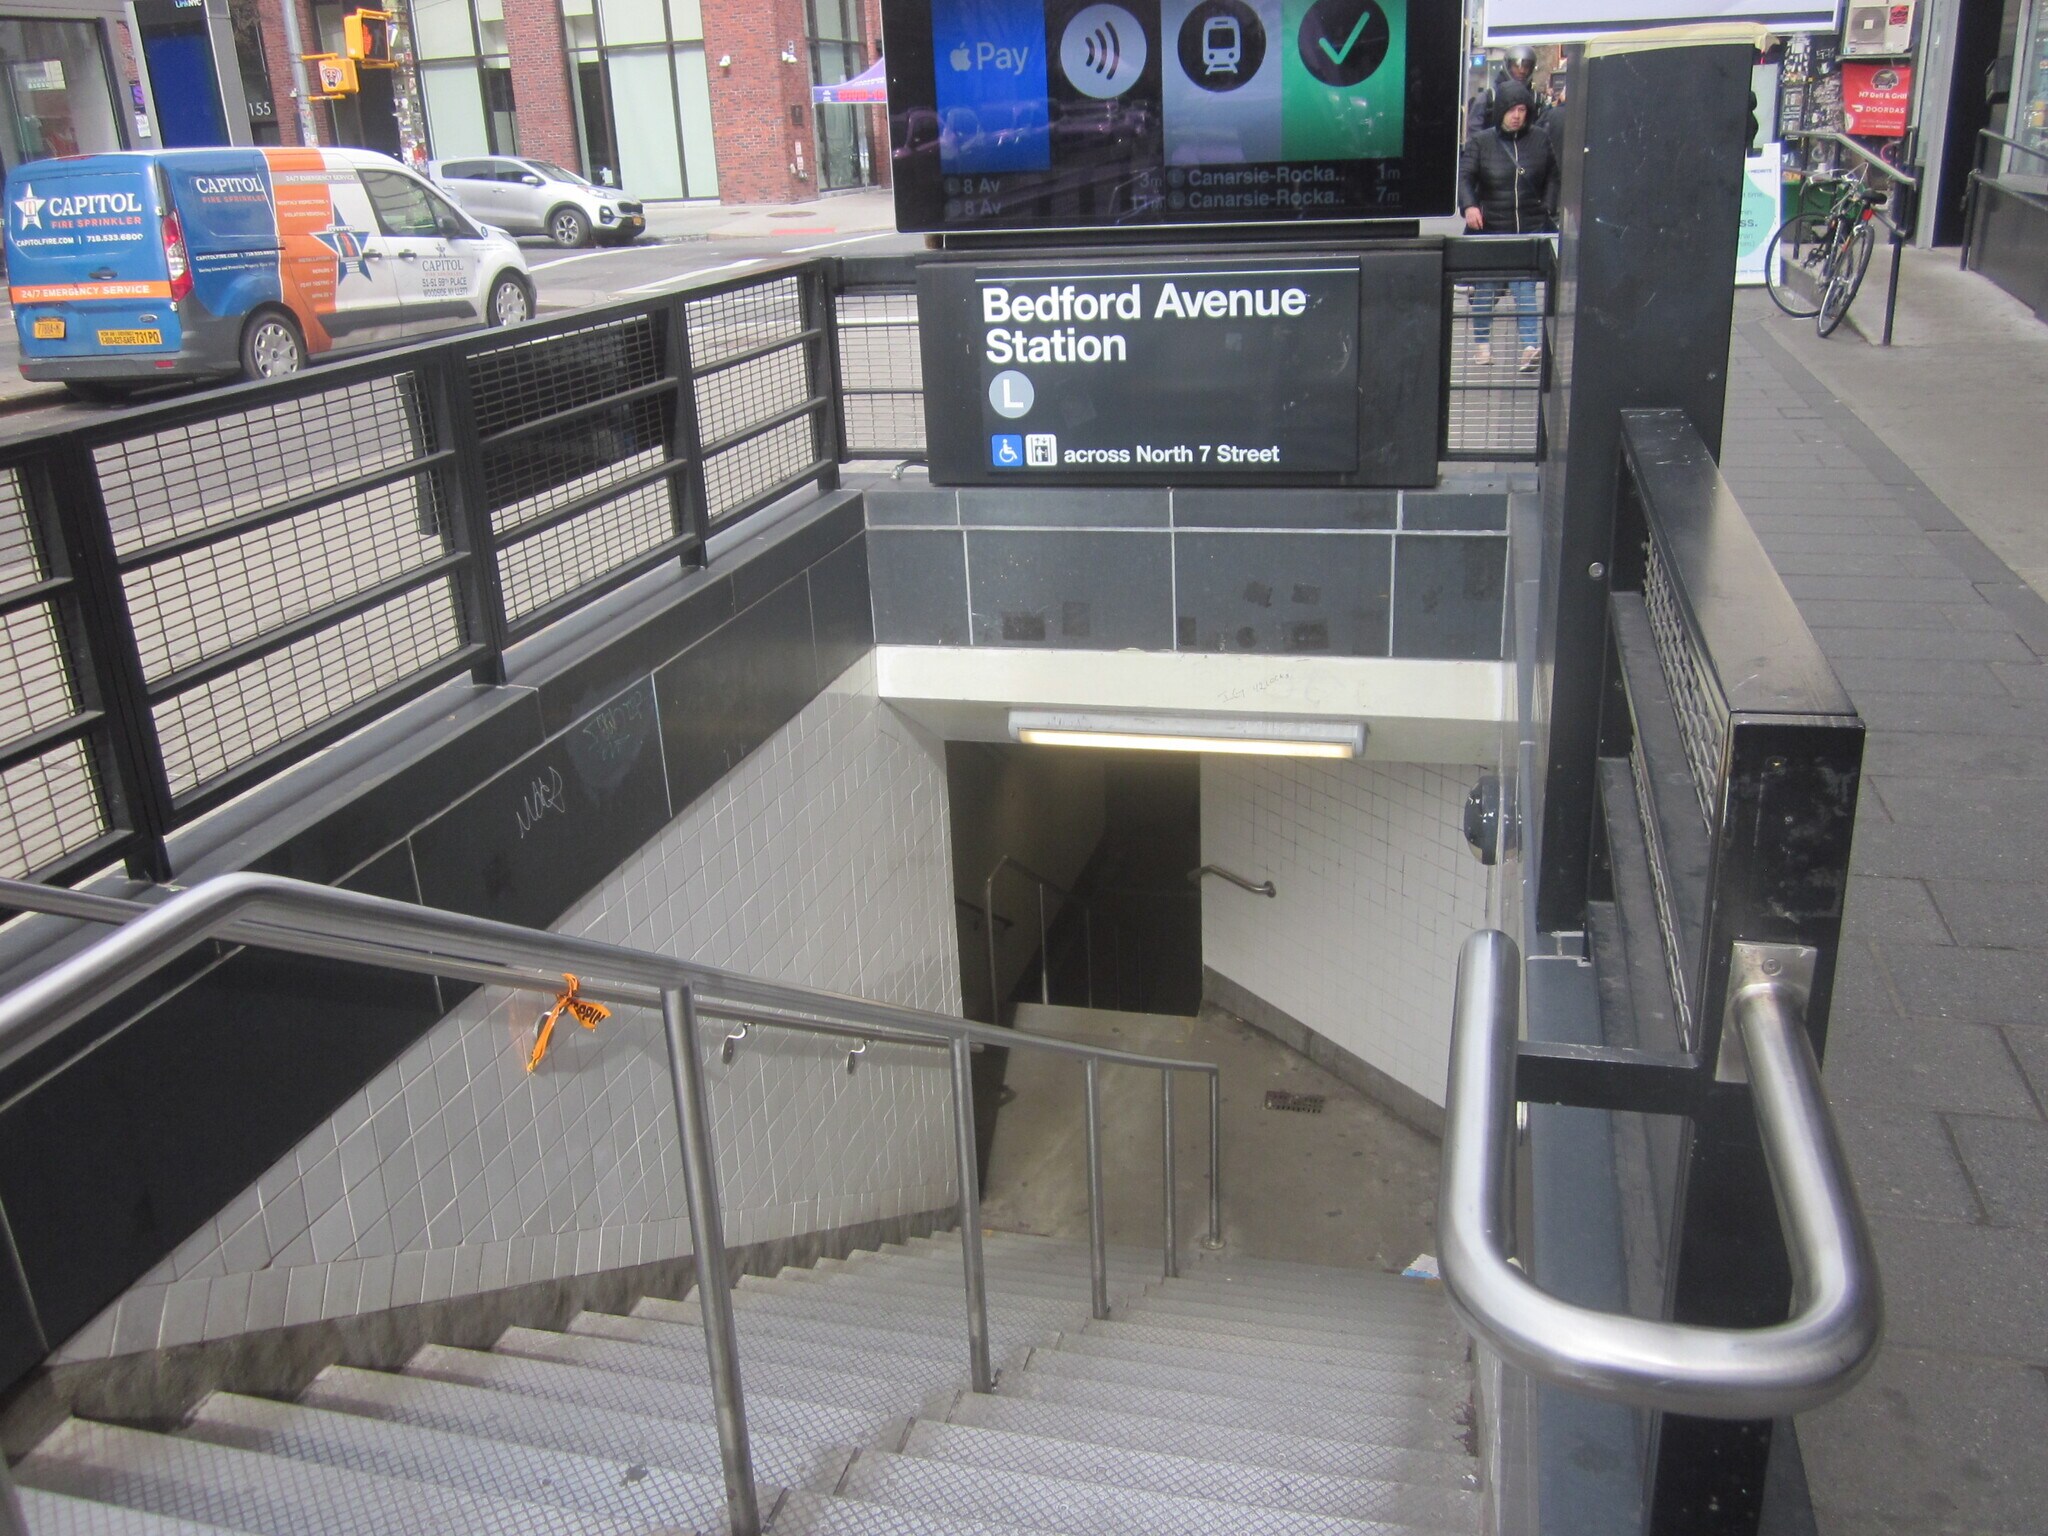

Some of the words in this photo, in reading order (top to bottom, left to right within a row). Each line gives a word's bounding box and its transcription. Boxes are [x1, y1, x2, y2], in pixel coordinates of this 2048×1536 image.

[976, 41, 1029, 75] Pay
[249, 101, 271, 117] 155
[196, 177, 265, 194] CAPITOL
[963, 178, 974, 194] 8
[978, 178, 1001, 194] Av
[49, 193, 142, 217] CAPITOL
[964, 200, 975, 215] 8
[980, 199, 1001, 215] Av
[51, 220, 74, 229] FIRE
[77, 216, 142, 228] SPRINKLER
[16, 236, 75, 247] CAPITOLFIRE.COM
[422, 259, 464, 272] CAPITOL
[449, 276, 467, 286] PLACE
[21, 289, 41, 299] 24/7
[43, 286, 100, 297] EMERGENCY
[103, 284, 150, 295] SERVICE
[982, 283, 1142, 323] Bedford
[1153, 282, 1307, 319] Avenue
[135, 331, 161, 344] 731PQ
[985, 328, 1127, 364] Station
[1002, 379, 1025, 409] L
[1063, 447, 1131, 464] across
[1136, 444, 1194, 464] North
[1198, 445, 1212, 463] 7
[1216, 445, 1281, 463] Street
